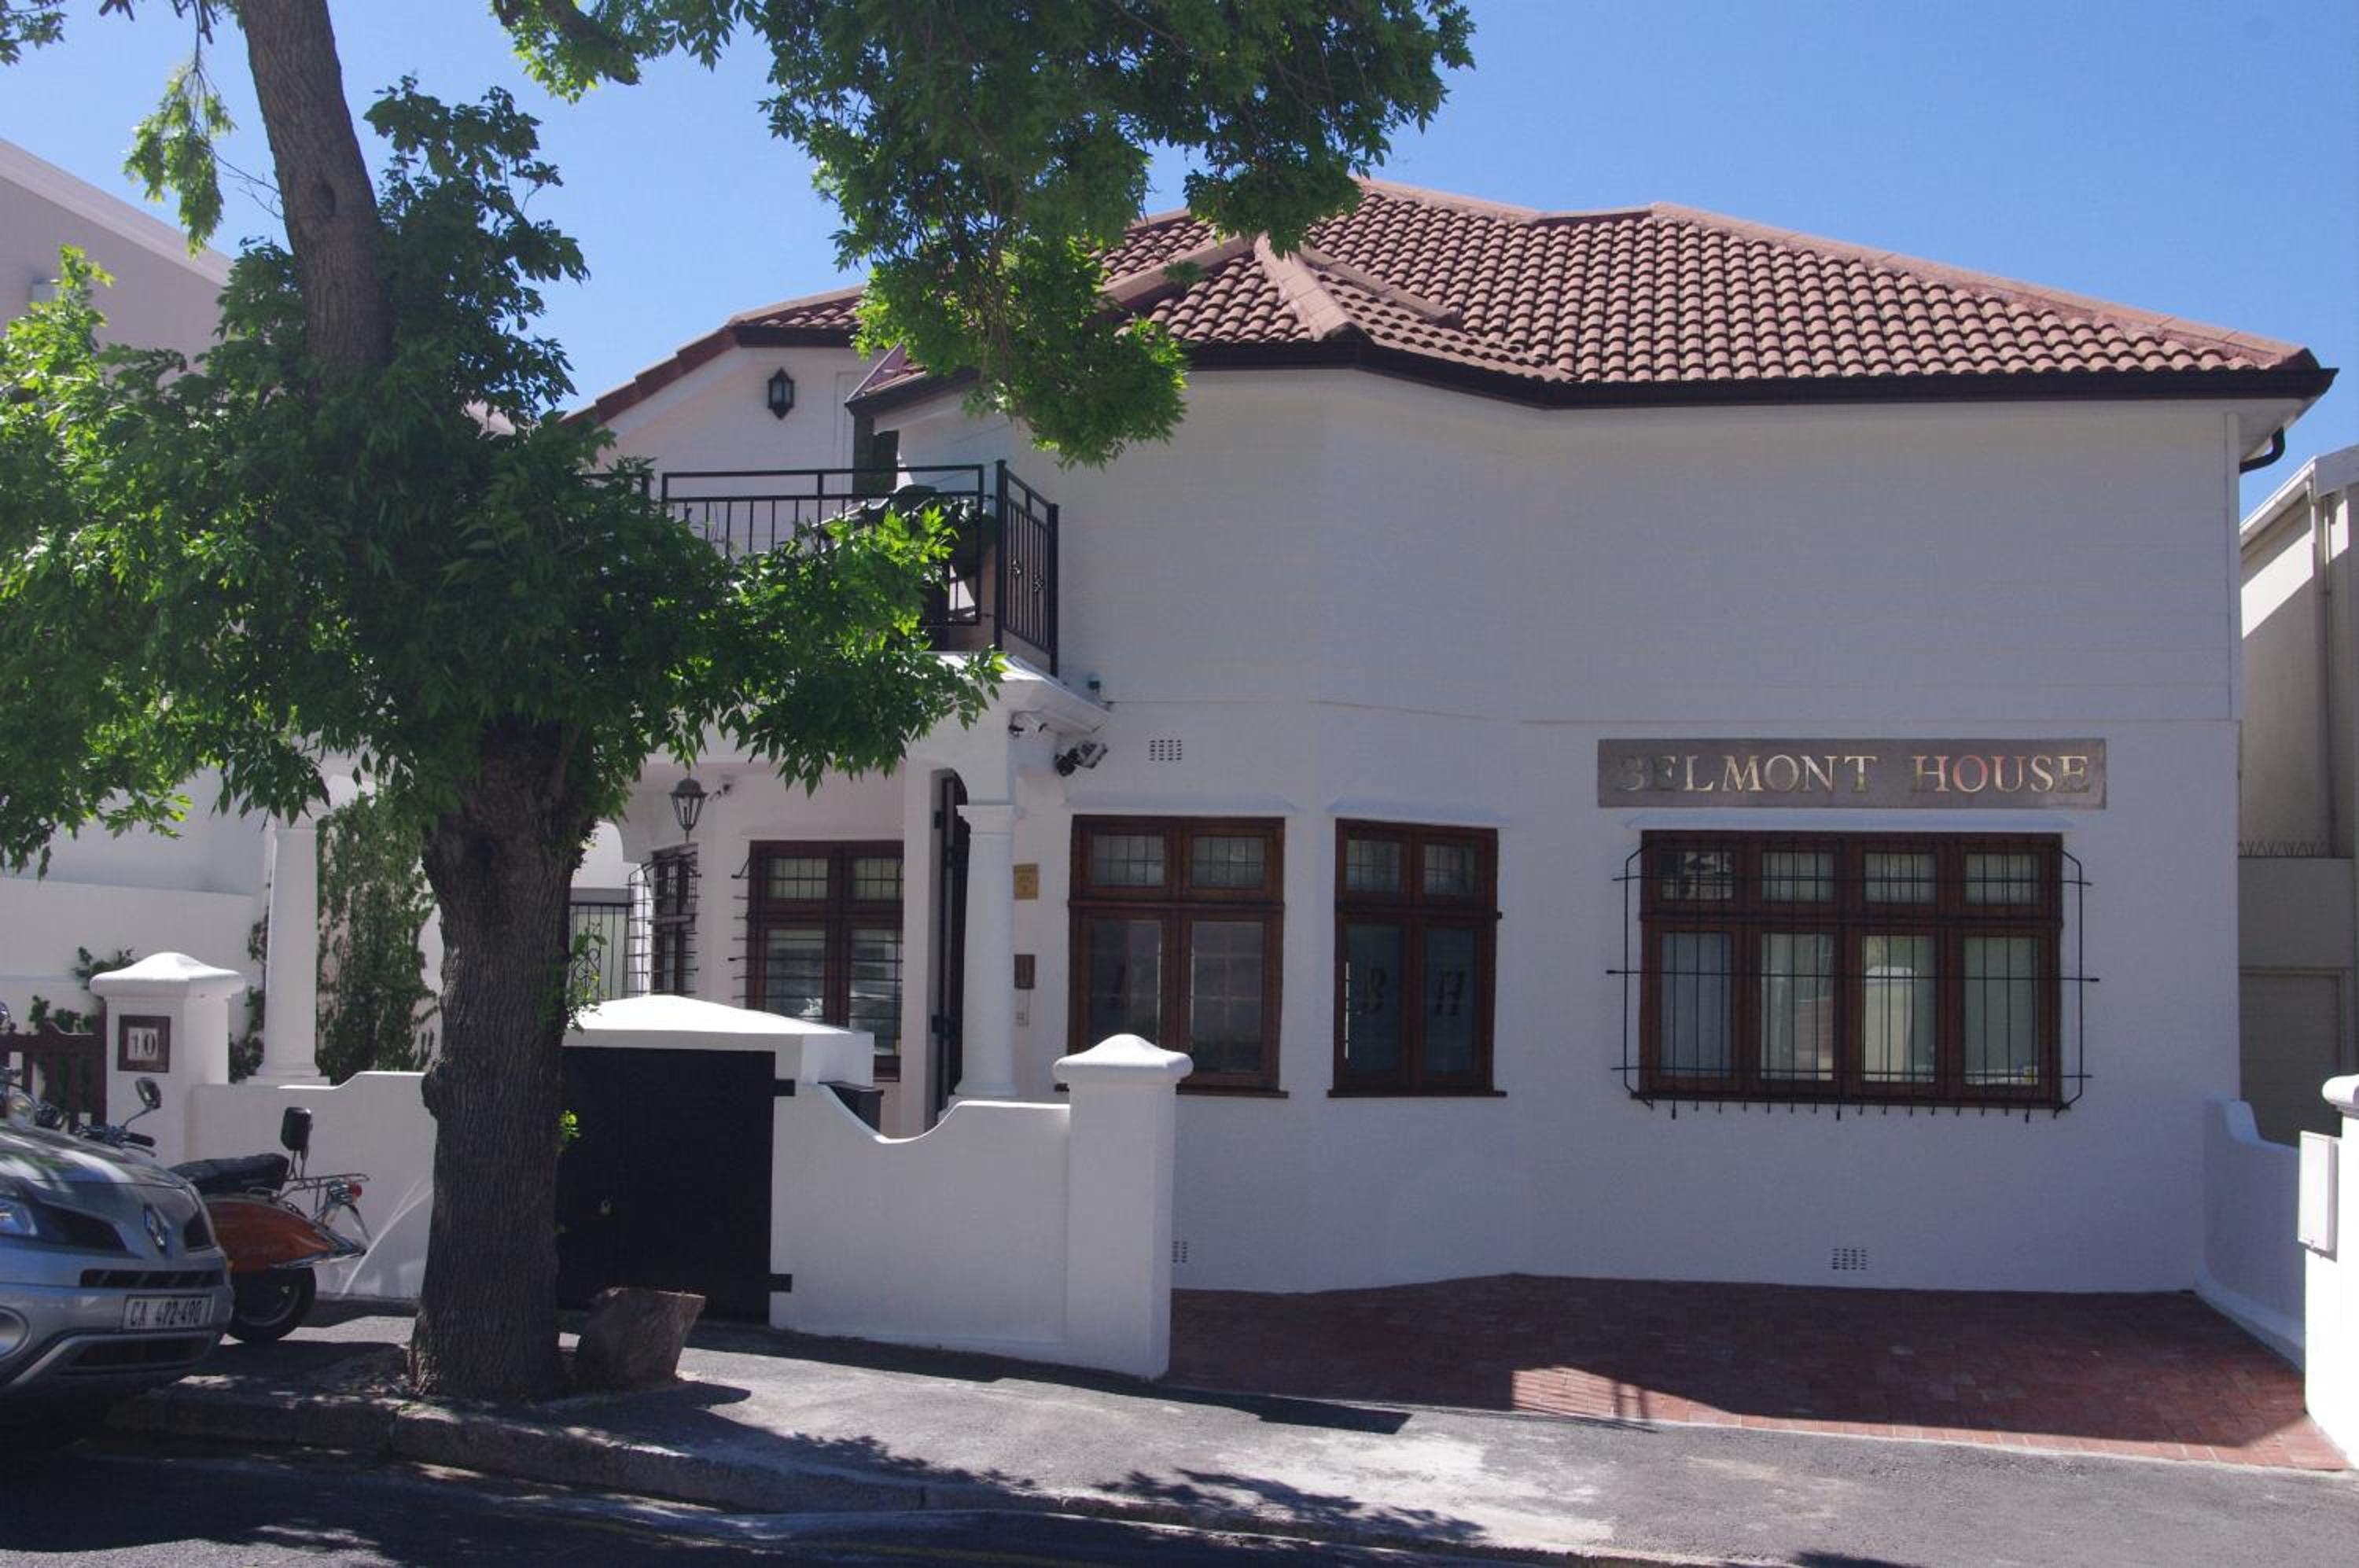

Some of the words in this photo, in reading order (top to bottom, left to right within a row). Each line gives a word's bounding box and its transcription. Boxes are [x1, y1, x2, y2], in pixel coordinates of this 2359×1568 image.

[1614, 755, 1878, 793] BELMONT
[1912, 755, 2091, 793] HOUSE
[132, 1033, 156, 1058] 10
[131, 1301, 147, 1326] CA
